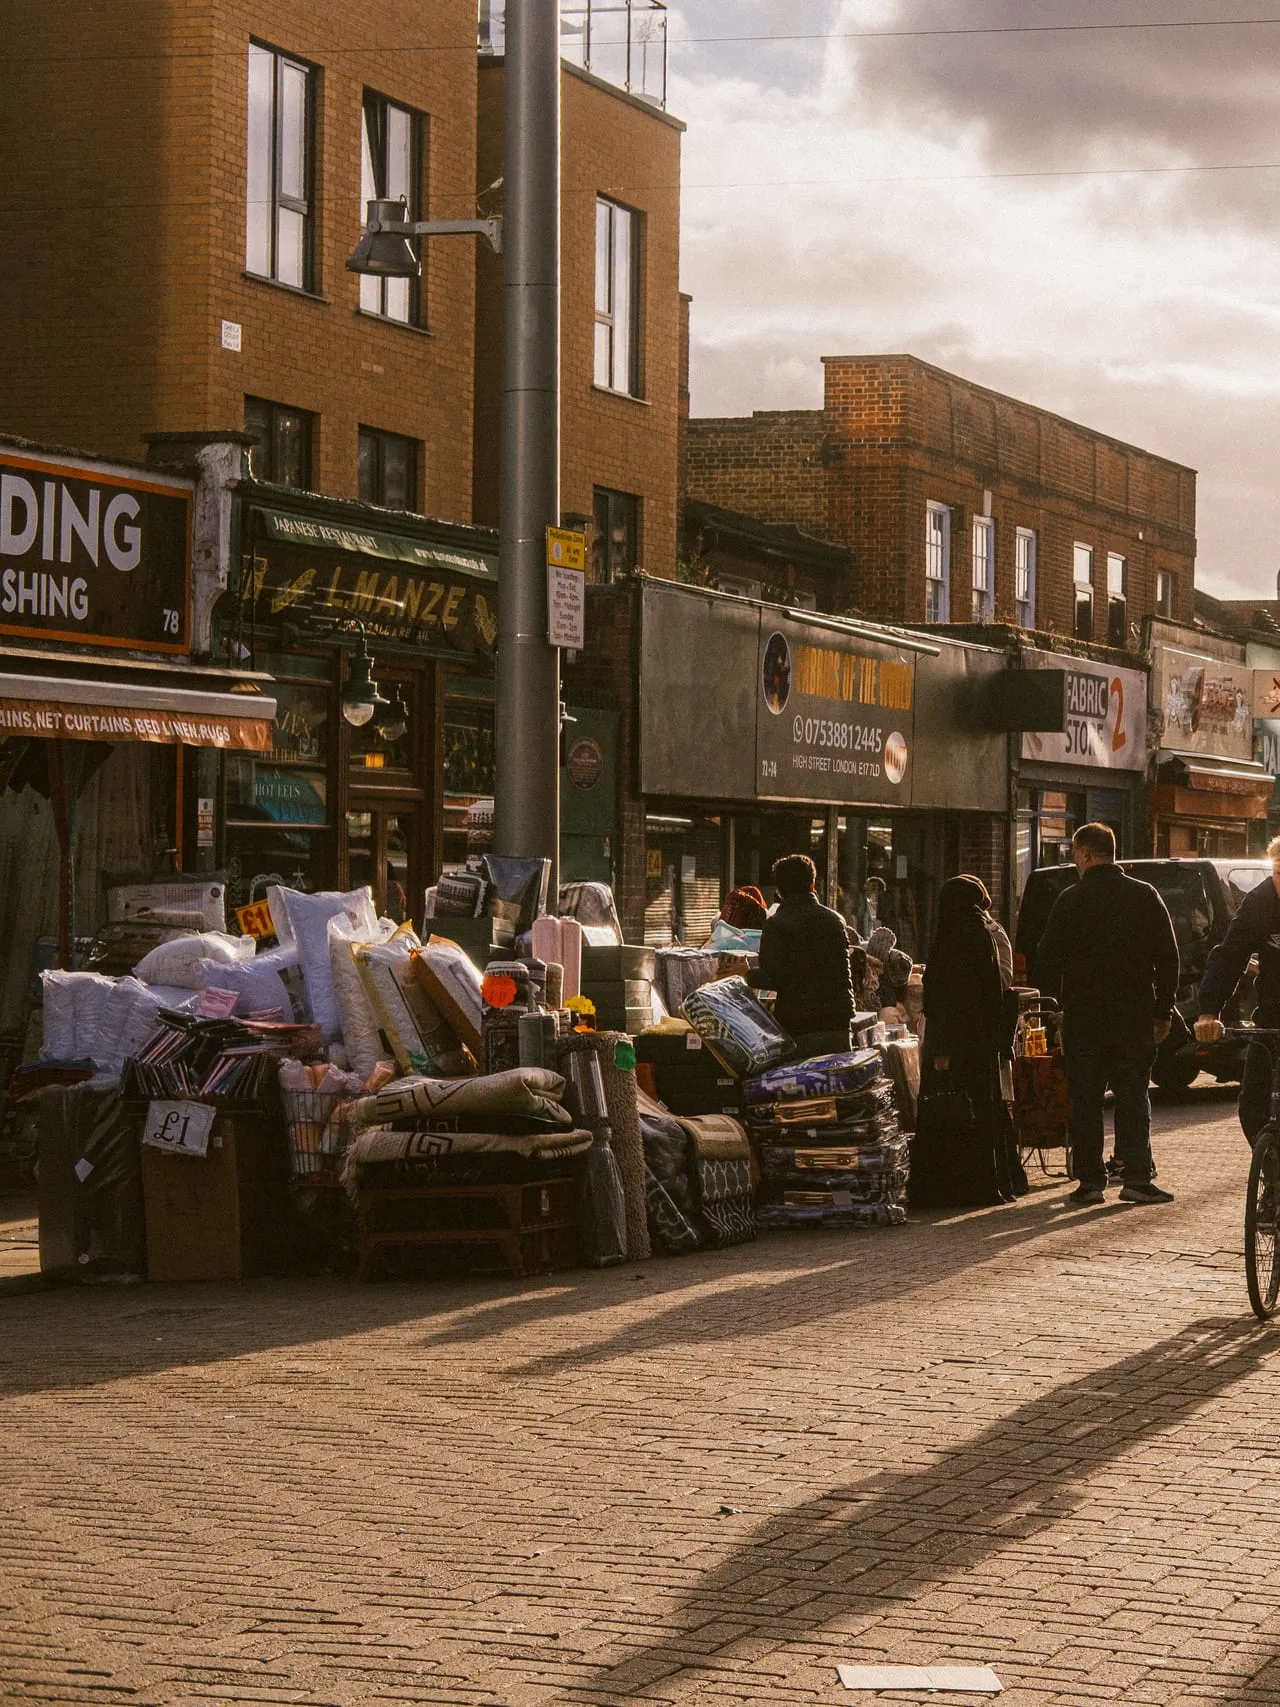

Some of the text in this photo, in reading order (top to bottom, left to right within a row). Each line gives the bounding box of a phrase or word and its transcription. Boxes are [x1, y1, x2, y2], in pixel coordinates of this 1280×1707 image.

[0, 473, 141, 572] DING
[273, 516, 379, 549] JAPANESE RESTAURANT
[1, 568, 89, 620] SHING
[162, 608, 180, 634] 78
[1066, 675, 1107, 716] FABRIC
[1109, 676, 1126, 753] 2
[200, 723, 231, 742] RUGS
[805, 718, 882, 753] 07538812445
[792, 754, 808, 769] HIGH
[808, 756, 832, 771] STREET
[832, 759, 857, 775] LONDON
[858, 762, 868, 776] E17
[254, 784, 301, 799] HOT EELS
[242, 902, 272, 934] £1
[154, 1111, 191, 1146] £1
